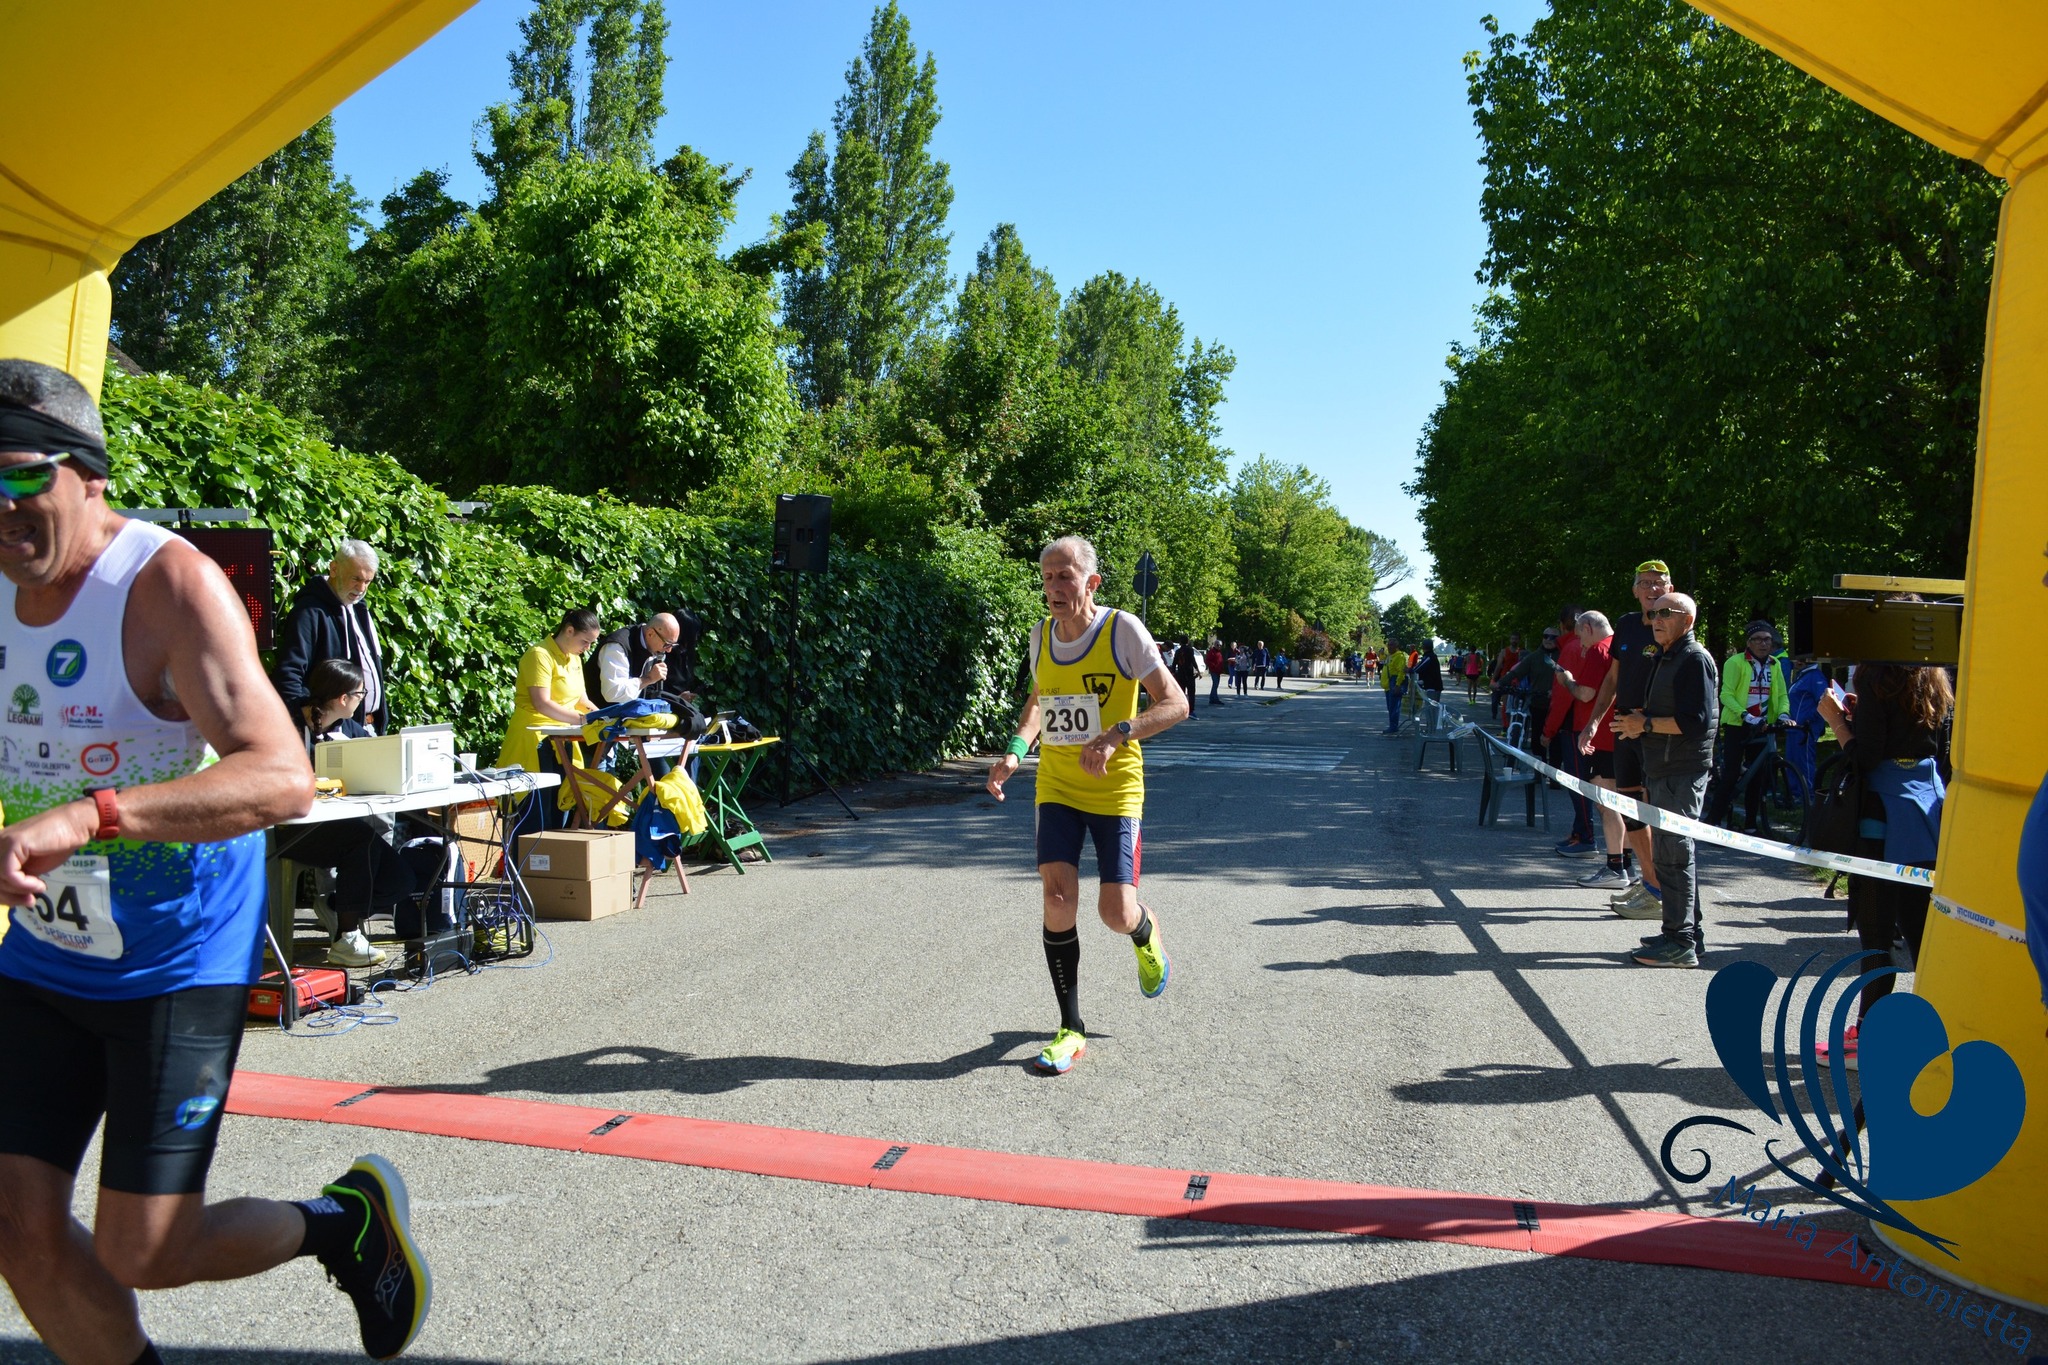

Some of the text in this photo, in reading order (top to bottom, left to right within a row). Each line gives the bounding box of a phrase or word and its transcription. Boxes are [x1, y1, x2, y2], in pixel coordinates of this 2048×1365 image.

[56, 651, 78, 675] 7
[7, 712, 43, 727] LEGNAMI
[1045, 707, 1089, 733] 230
[72, 859, 97, 867] UISP
